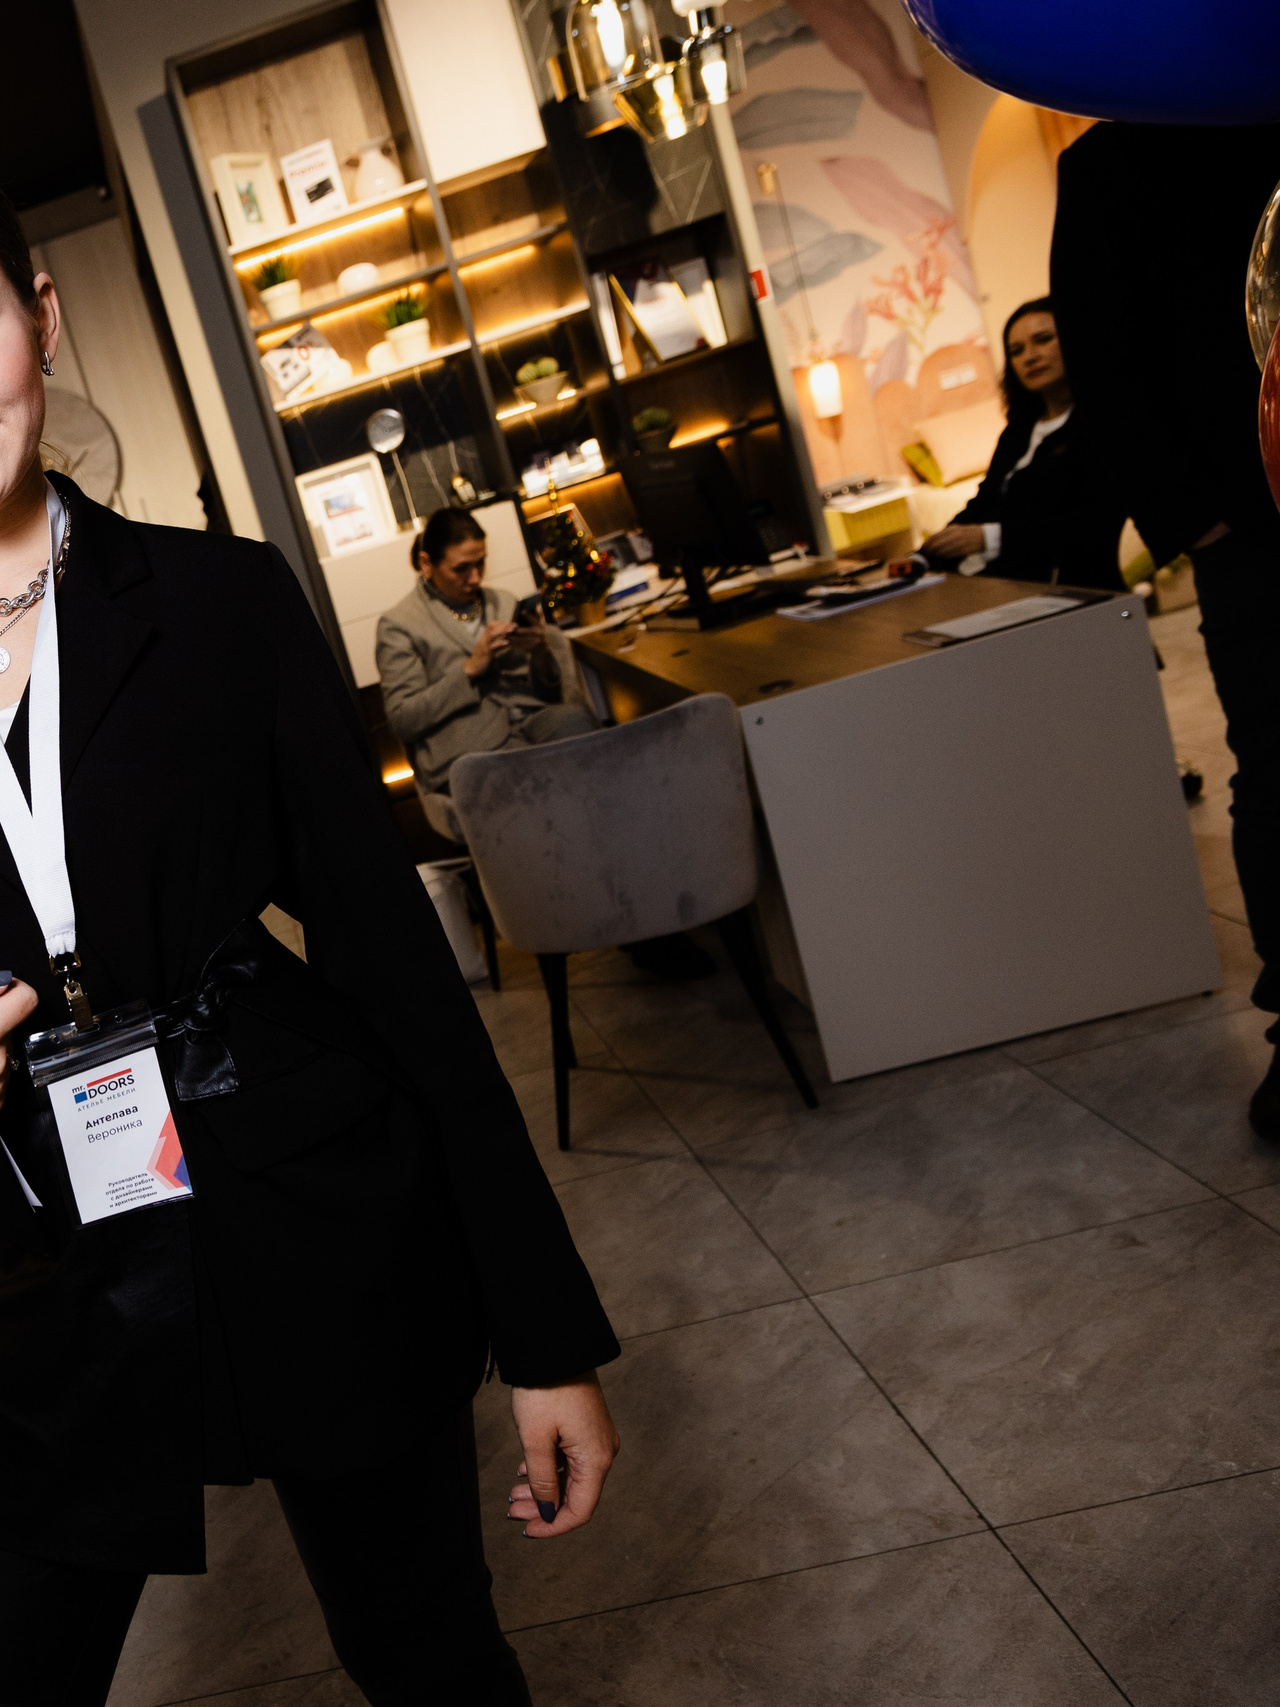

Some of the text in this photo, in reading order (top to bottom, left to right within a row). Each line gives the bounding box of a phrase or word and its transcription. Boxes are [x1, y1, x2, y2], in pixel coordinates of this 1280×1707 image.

[71, 1085, 86, 1094] mr.
[88, 1074, 135, 1099] DOORS
[77, 1088, 136, 1112] АТЕЛЬЕ МЕБЕЛИ
[85, 1105, 139, 1130] Антелава
[87, 1119, 143, 1144] Вероника
[108, 1173, 148, 1187] Руководитель
